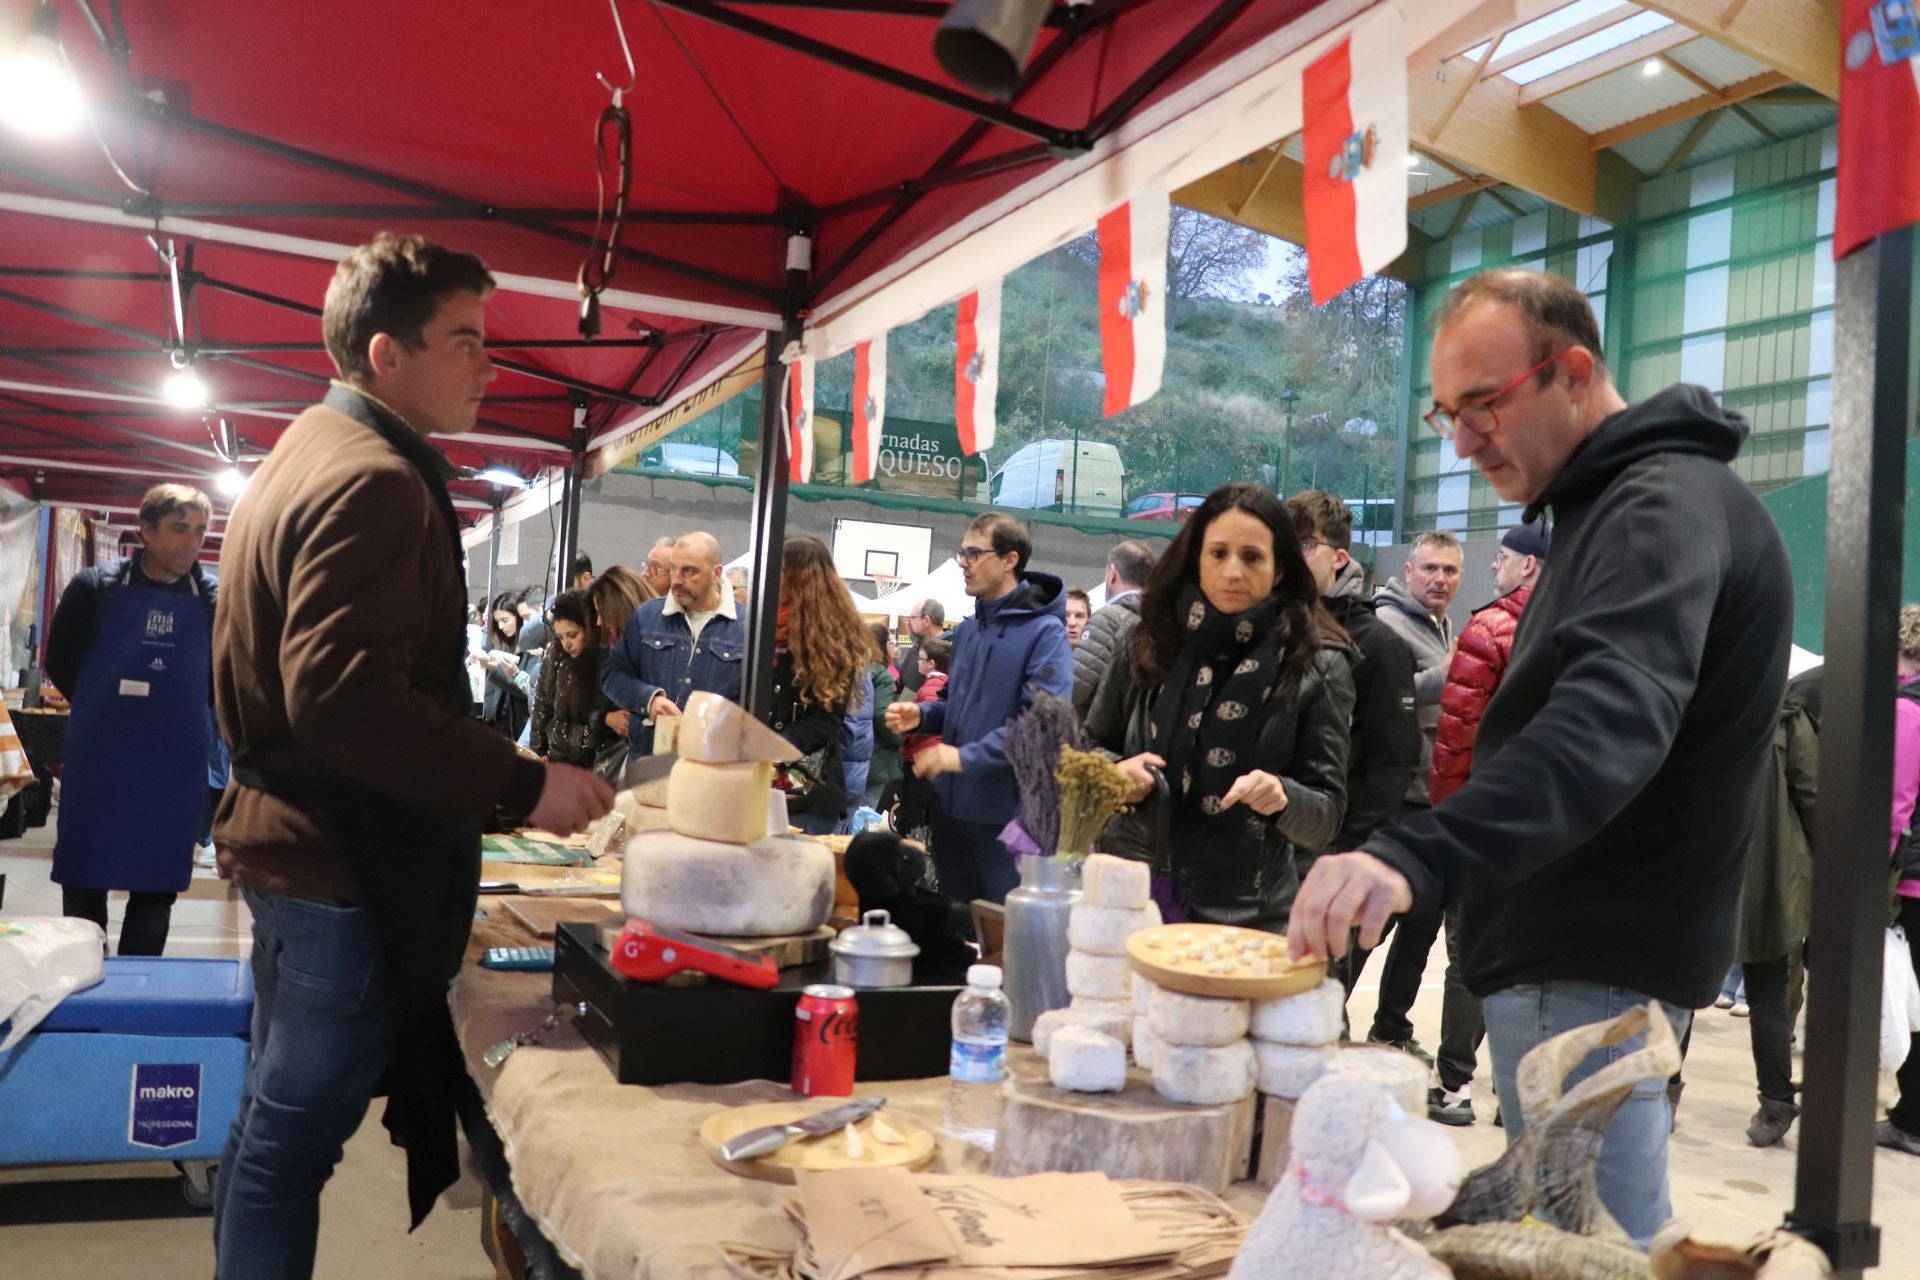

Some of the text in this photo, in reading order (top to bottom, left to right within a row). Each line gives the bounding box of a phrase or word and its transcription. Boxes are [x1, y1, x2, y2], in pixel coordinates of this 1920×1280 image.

[880, 433, 940, 452] rnadas
[878, 449, 963, 479] QUESO
[140, 1085, 195, 1099] makro
